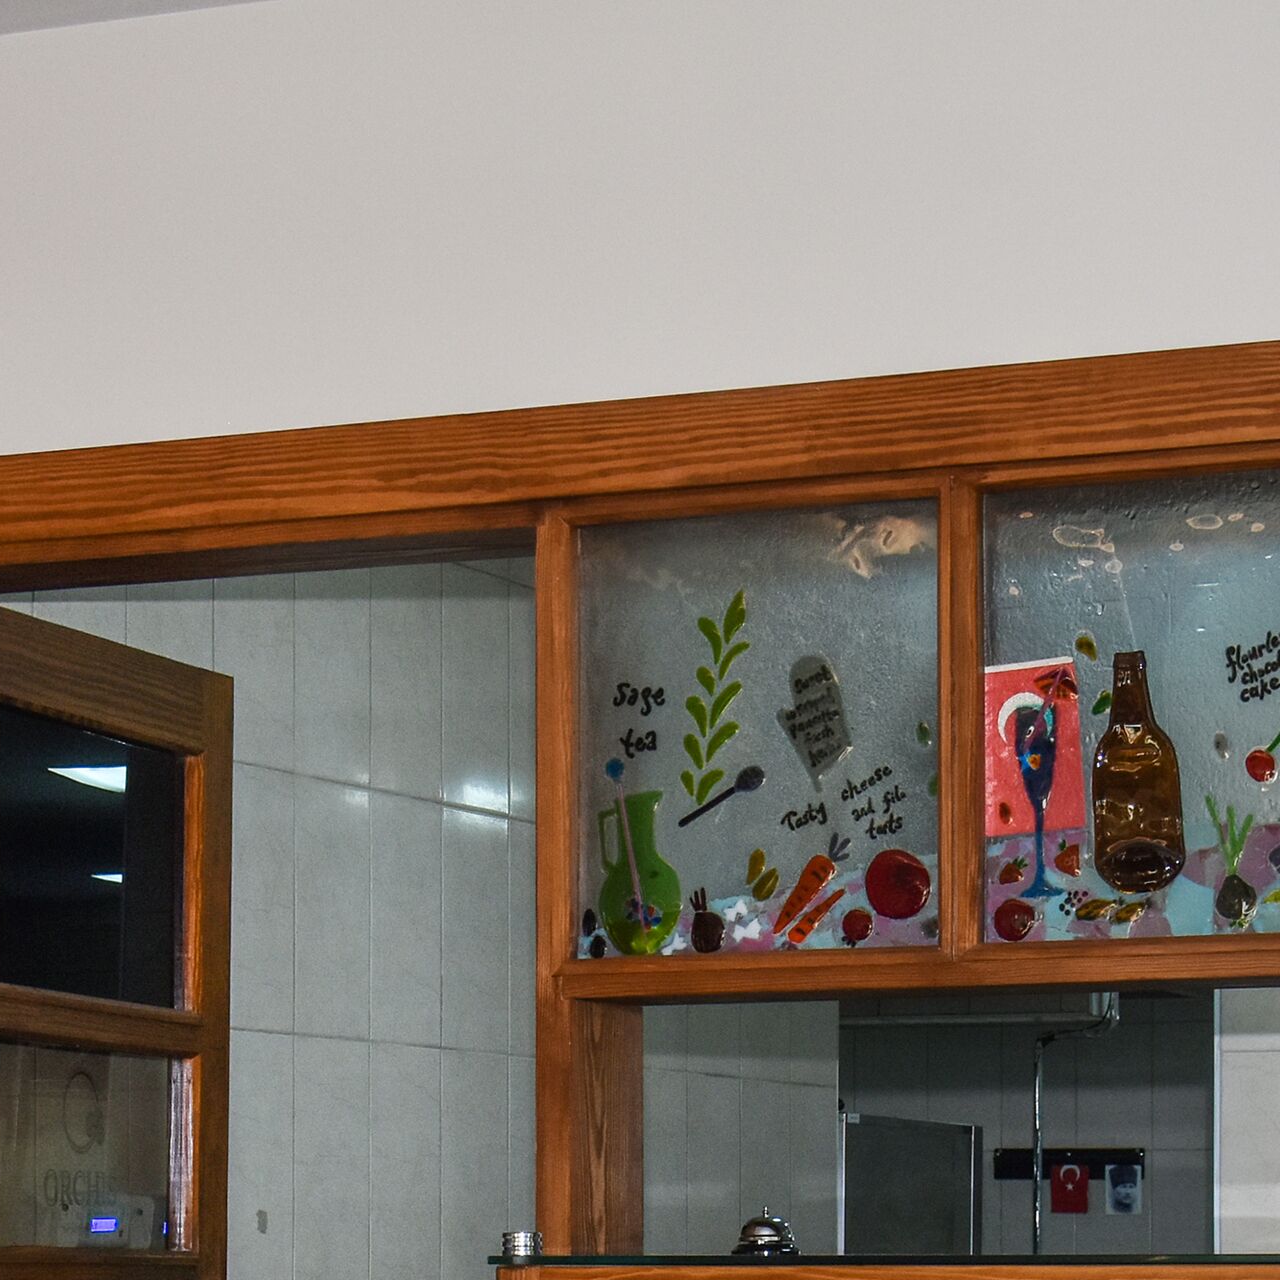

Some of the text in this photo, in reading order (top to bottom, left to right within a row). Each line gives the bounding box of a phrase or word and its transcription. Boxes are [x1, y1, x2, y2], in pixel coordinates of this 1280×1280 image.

[612, 682, 666, 717] Sage
[619, 727, 658, 760] tea
[841, 765, 893, 802] cheese
[780, 801, 828, 832] Tasty
